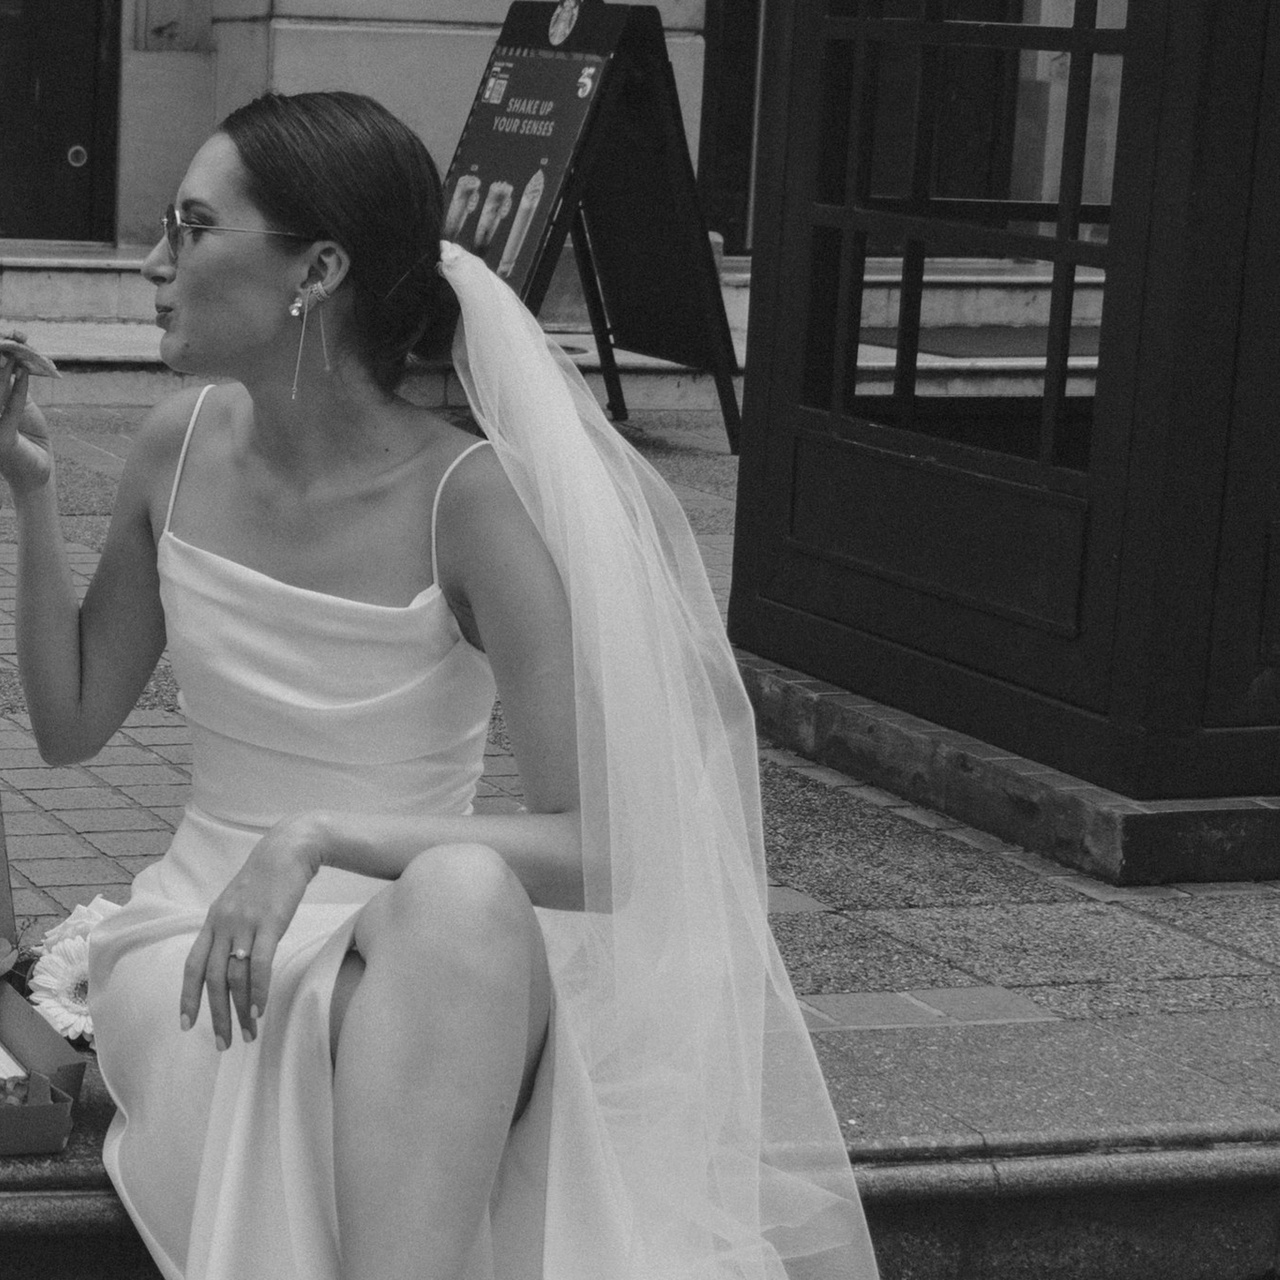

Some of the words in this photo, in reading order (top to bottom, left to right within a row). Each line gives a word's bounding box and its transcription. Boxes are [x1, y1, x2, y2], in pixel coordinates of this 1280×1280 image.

[506, 97, 539, 115] SHAKE
[539, 100, 554, 116] UP
[492, 116, 521, 133] YOUR
[519, 119, 555, 137] SENSES
